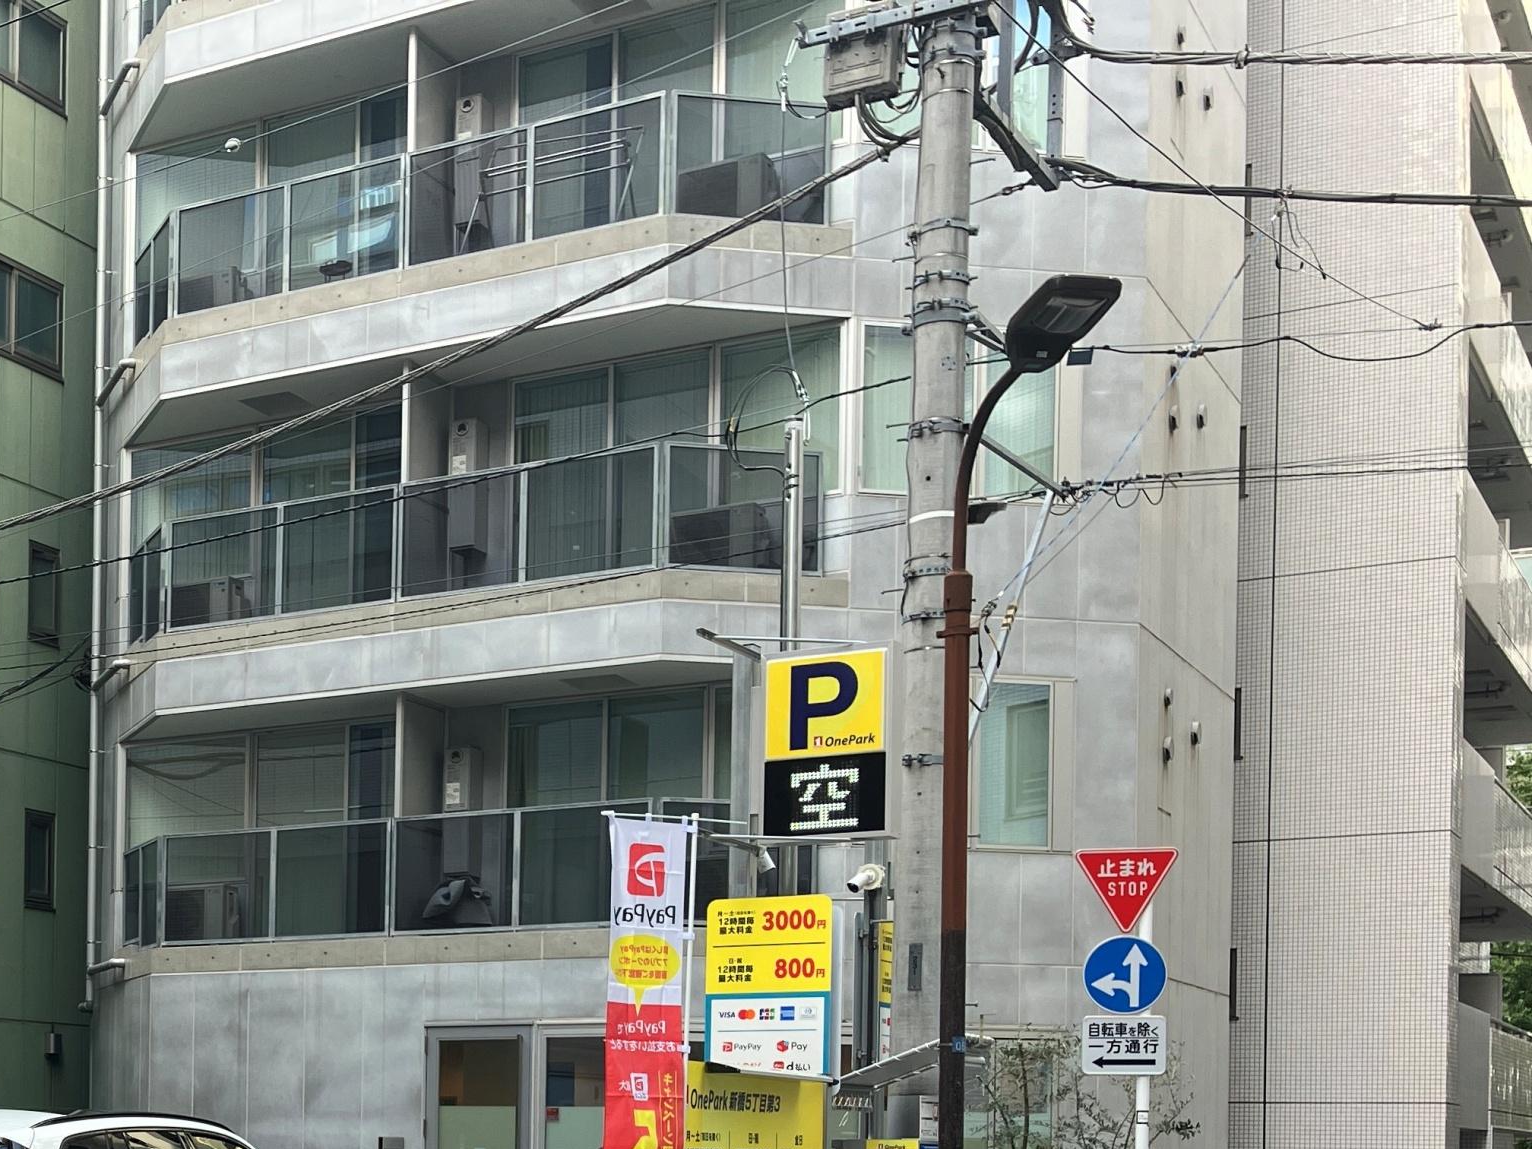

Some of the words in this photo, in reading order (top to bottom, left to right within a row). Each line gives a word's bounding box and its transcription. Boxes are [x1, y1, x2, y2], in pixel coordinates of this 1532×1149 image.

[790, 661, 858, 750] P
[825, 733, 875, 747] OnePark
[790, 764, 859, 831] 空
[1097, 859, 1157, 878] 止まれ
[1108, 881, 1148, 897] STOP
[719, 1011, 736, 1019] VISA
[1089, 1022, 1159, 1037] 自転車を除く
[1089, 1040, 1159, 1054] 一方通行
[691, 1089, 728, 1111] OnePark
